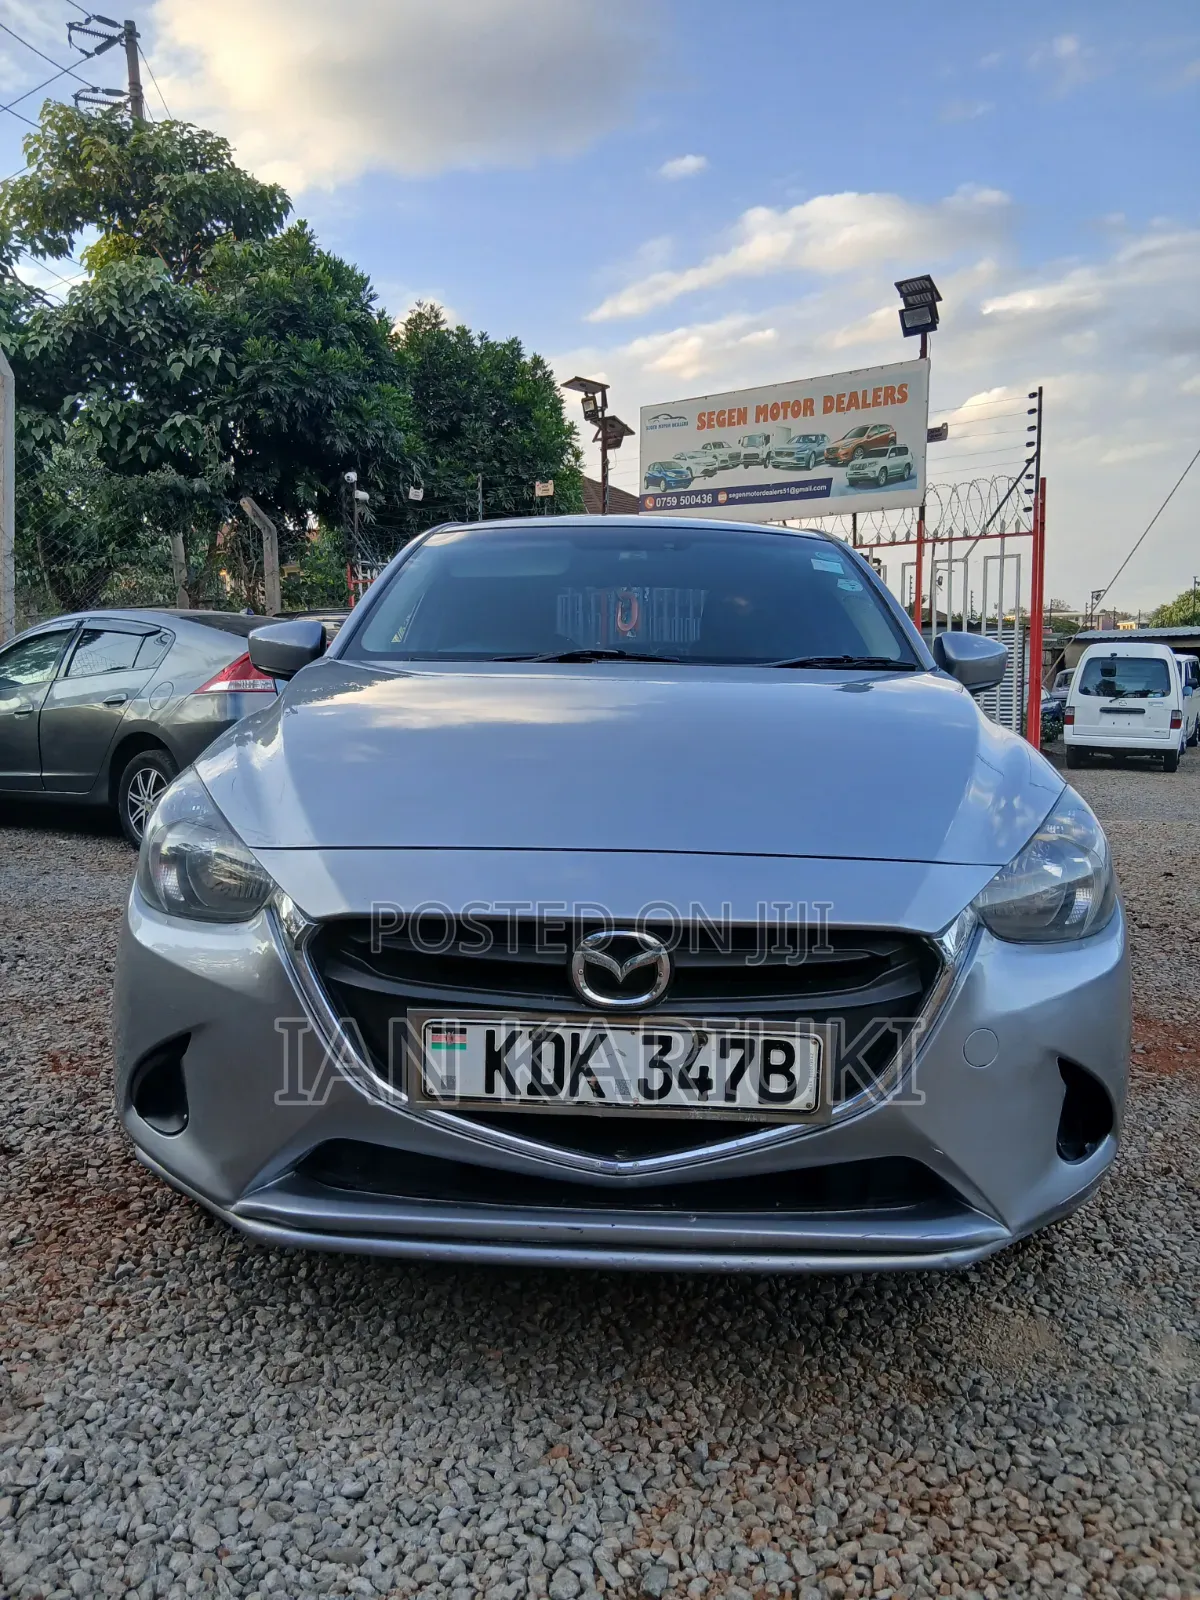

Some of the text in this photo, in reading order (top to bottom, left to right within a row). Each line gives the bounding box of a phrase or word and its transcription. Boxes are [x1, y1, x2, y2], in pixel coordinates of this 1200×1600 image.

[696, 383, 909, 431] SEGEN MOTOR DEALERS
[655, 485, 827, 507] 0759 500436 segenmotordealers51@gmail.com
[484, 1029, 609, 1099] KDK
[637, 1033, 798, 1105] 347B
